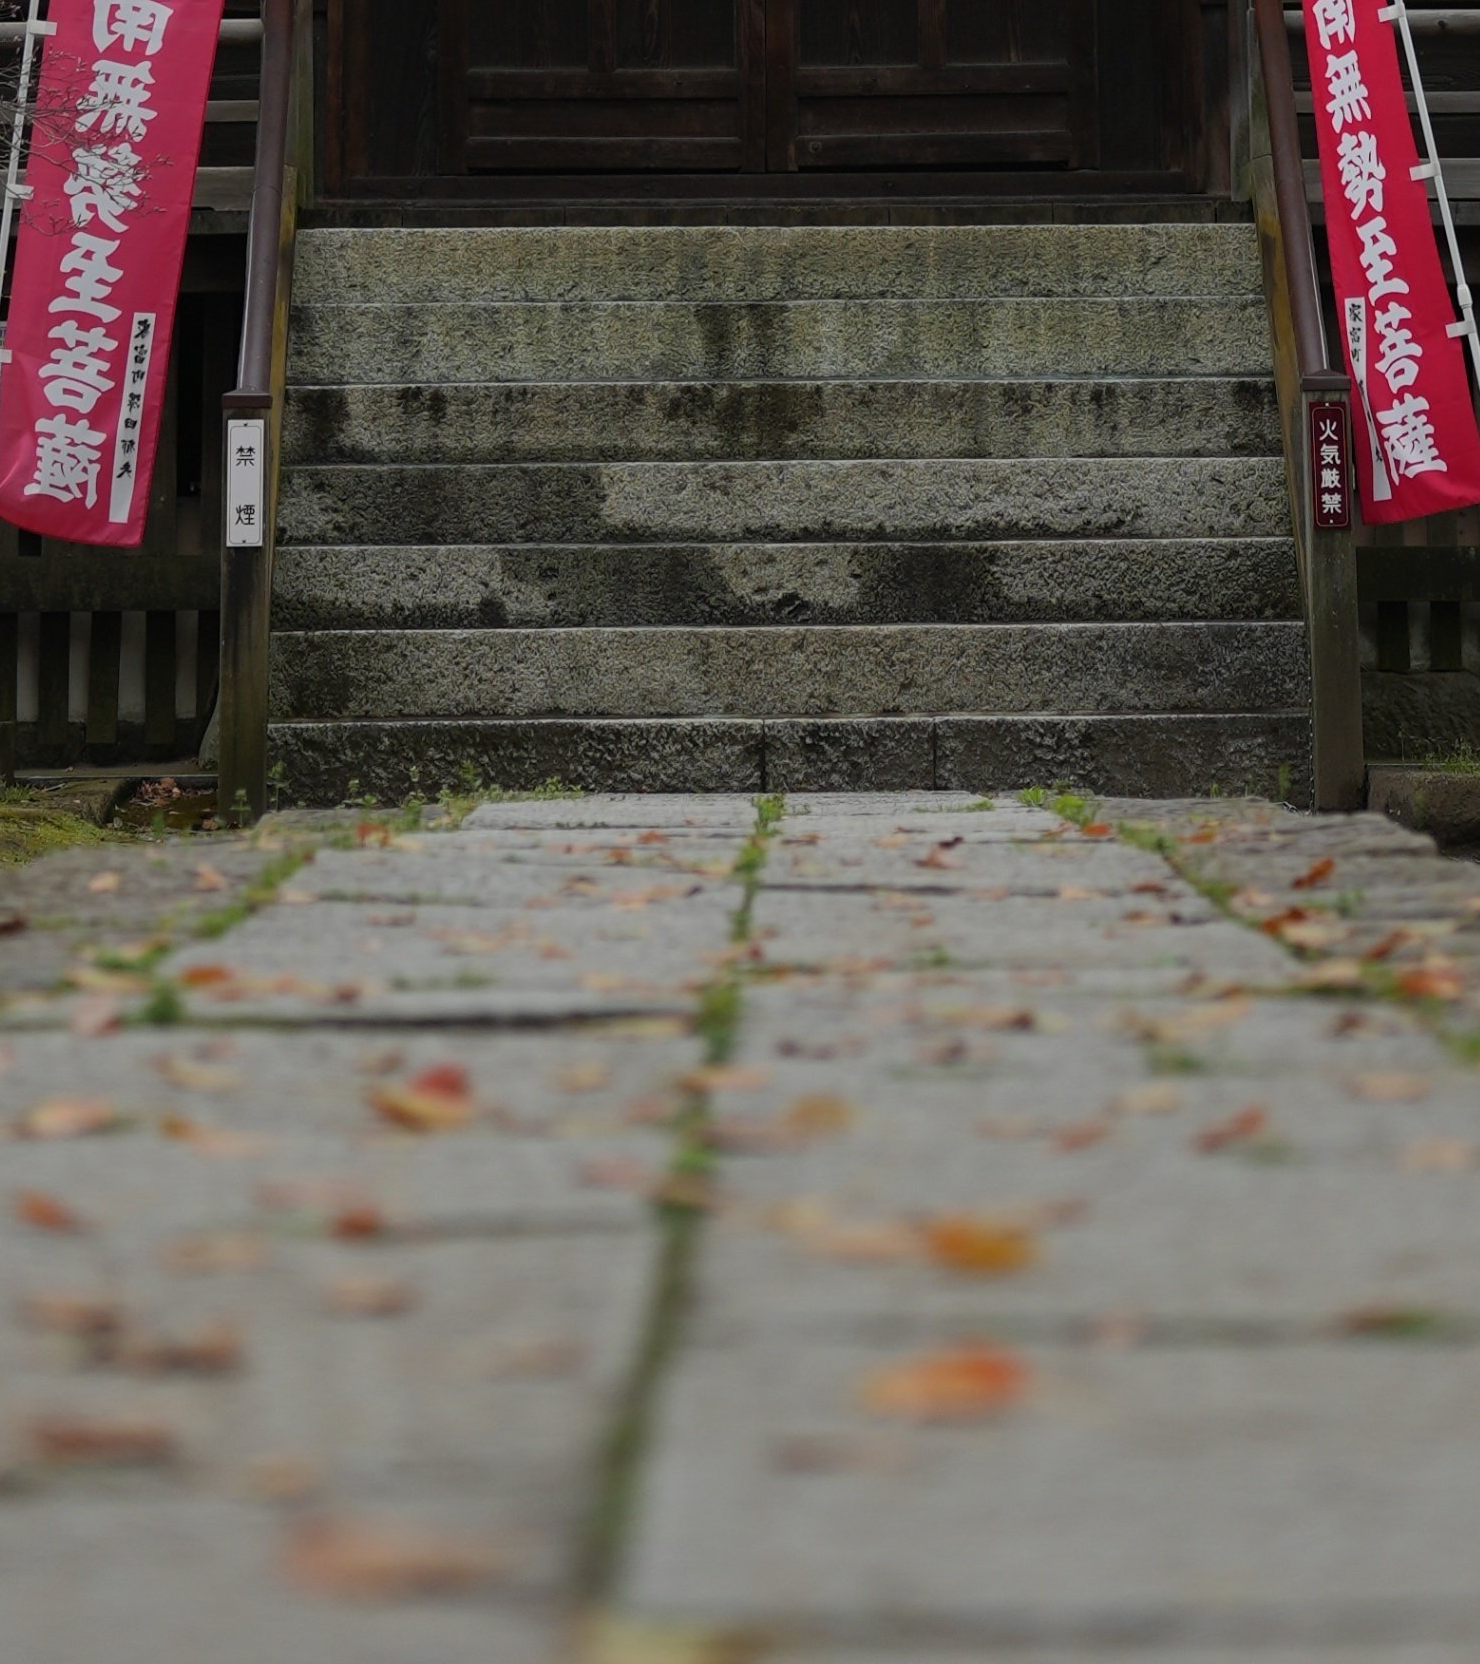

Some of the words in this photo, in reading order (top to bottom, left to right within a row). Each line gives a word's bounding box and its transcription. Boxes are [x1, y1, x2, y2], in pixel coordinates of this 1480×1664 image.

[235, 444, 256, 525] 禁煙
[1319, 419, 1342, 514] 火気厳禁
